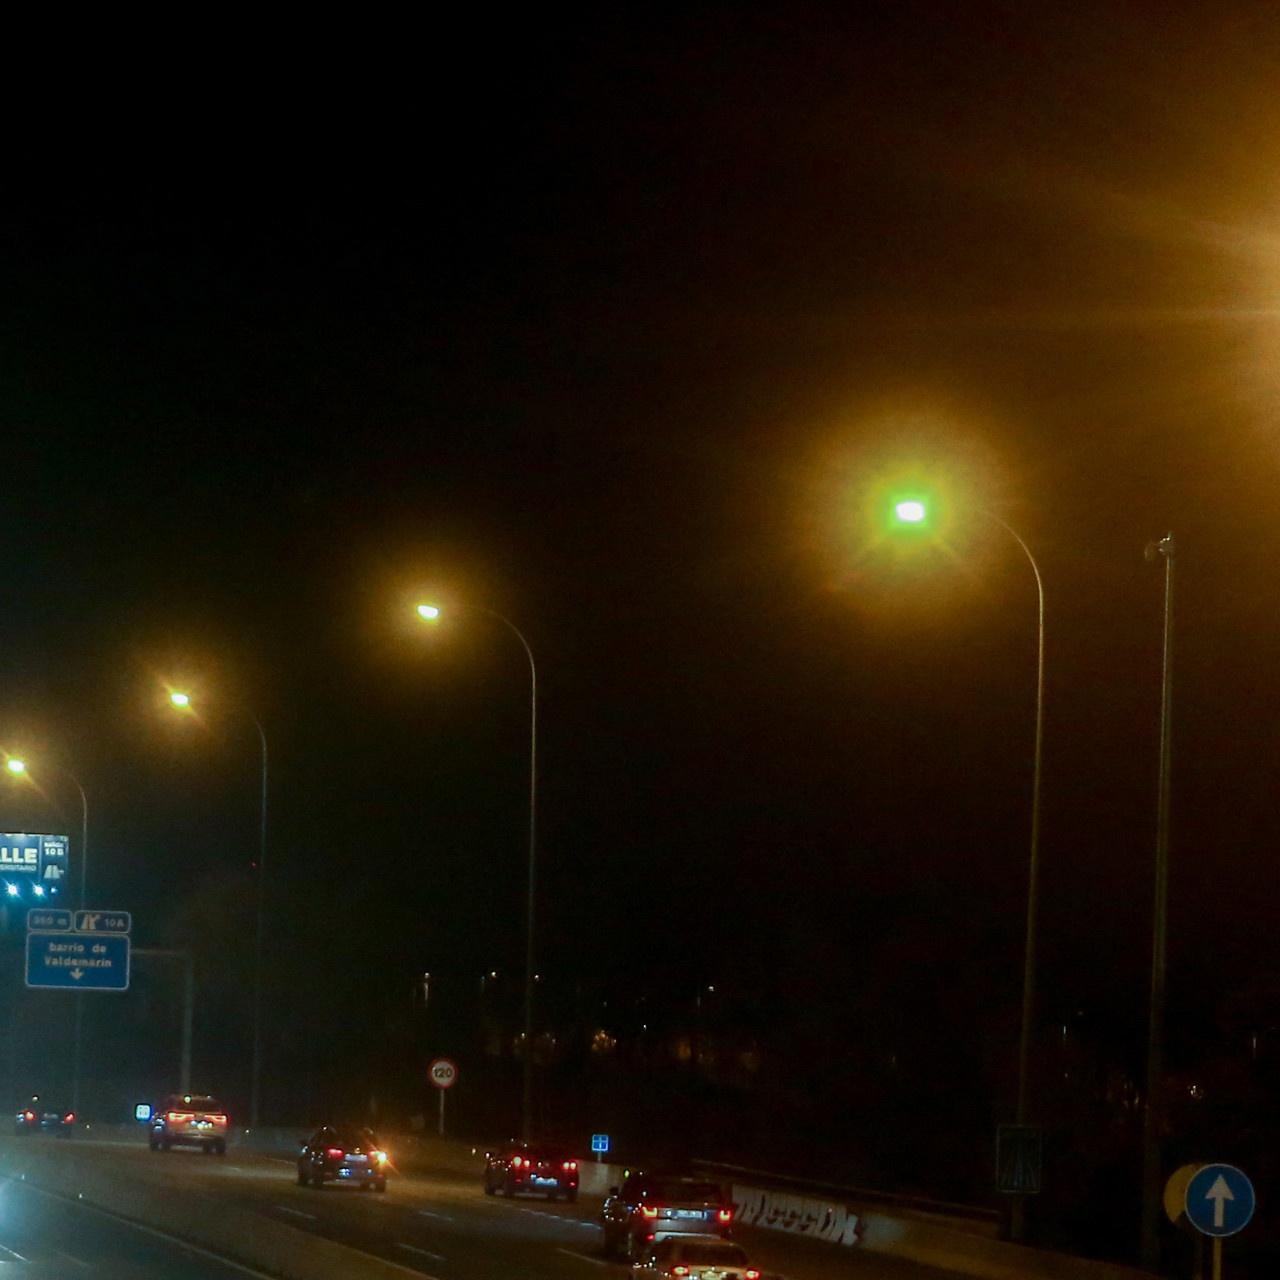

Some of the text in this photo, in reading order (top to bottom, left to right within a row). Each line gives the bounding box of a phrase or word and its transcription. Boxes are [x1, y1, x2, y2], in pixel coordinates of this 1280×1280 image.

[105, 918, 124, 927] 10A
[92, 943, 107, 953] de
[434, 1067, 453, 1078] 120
